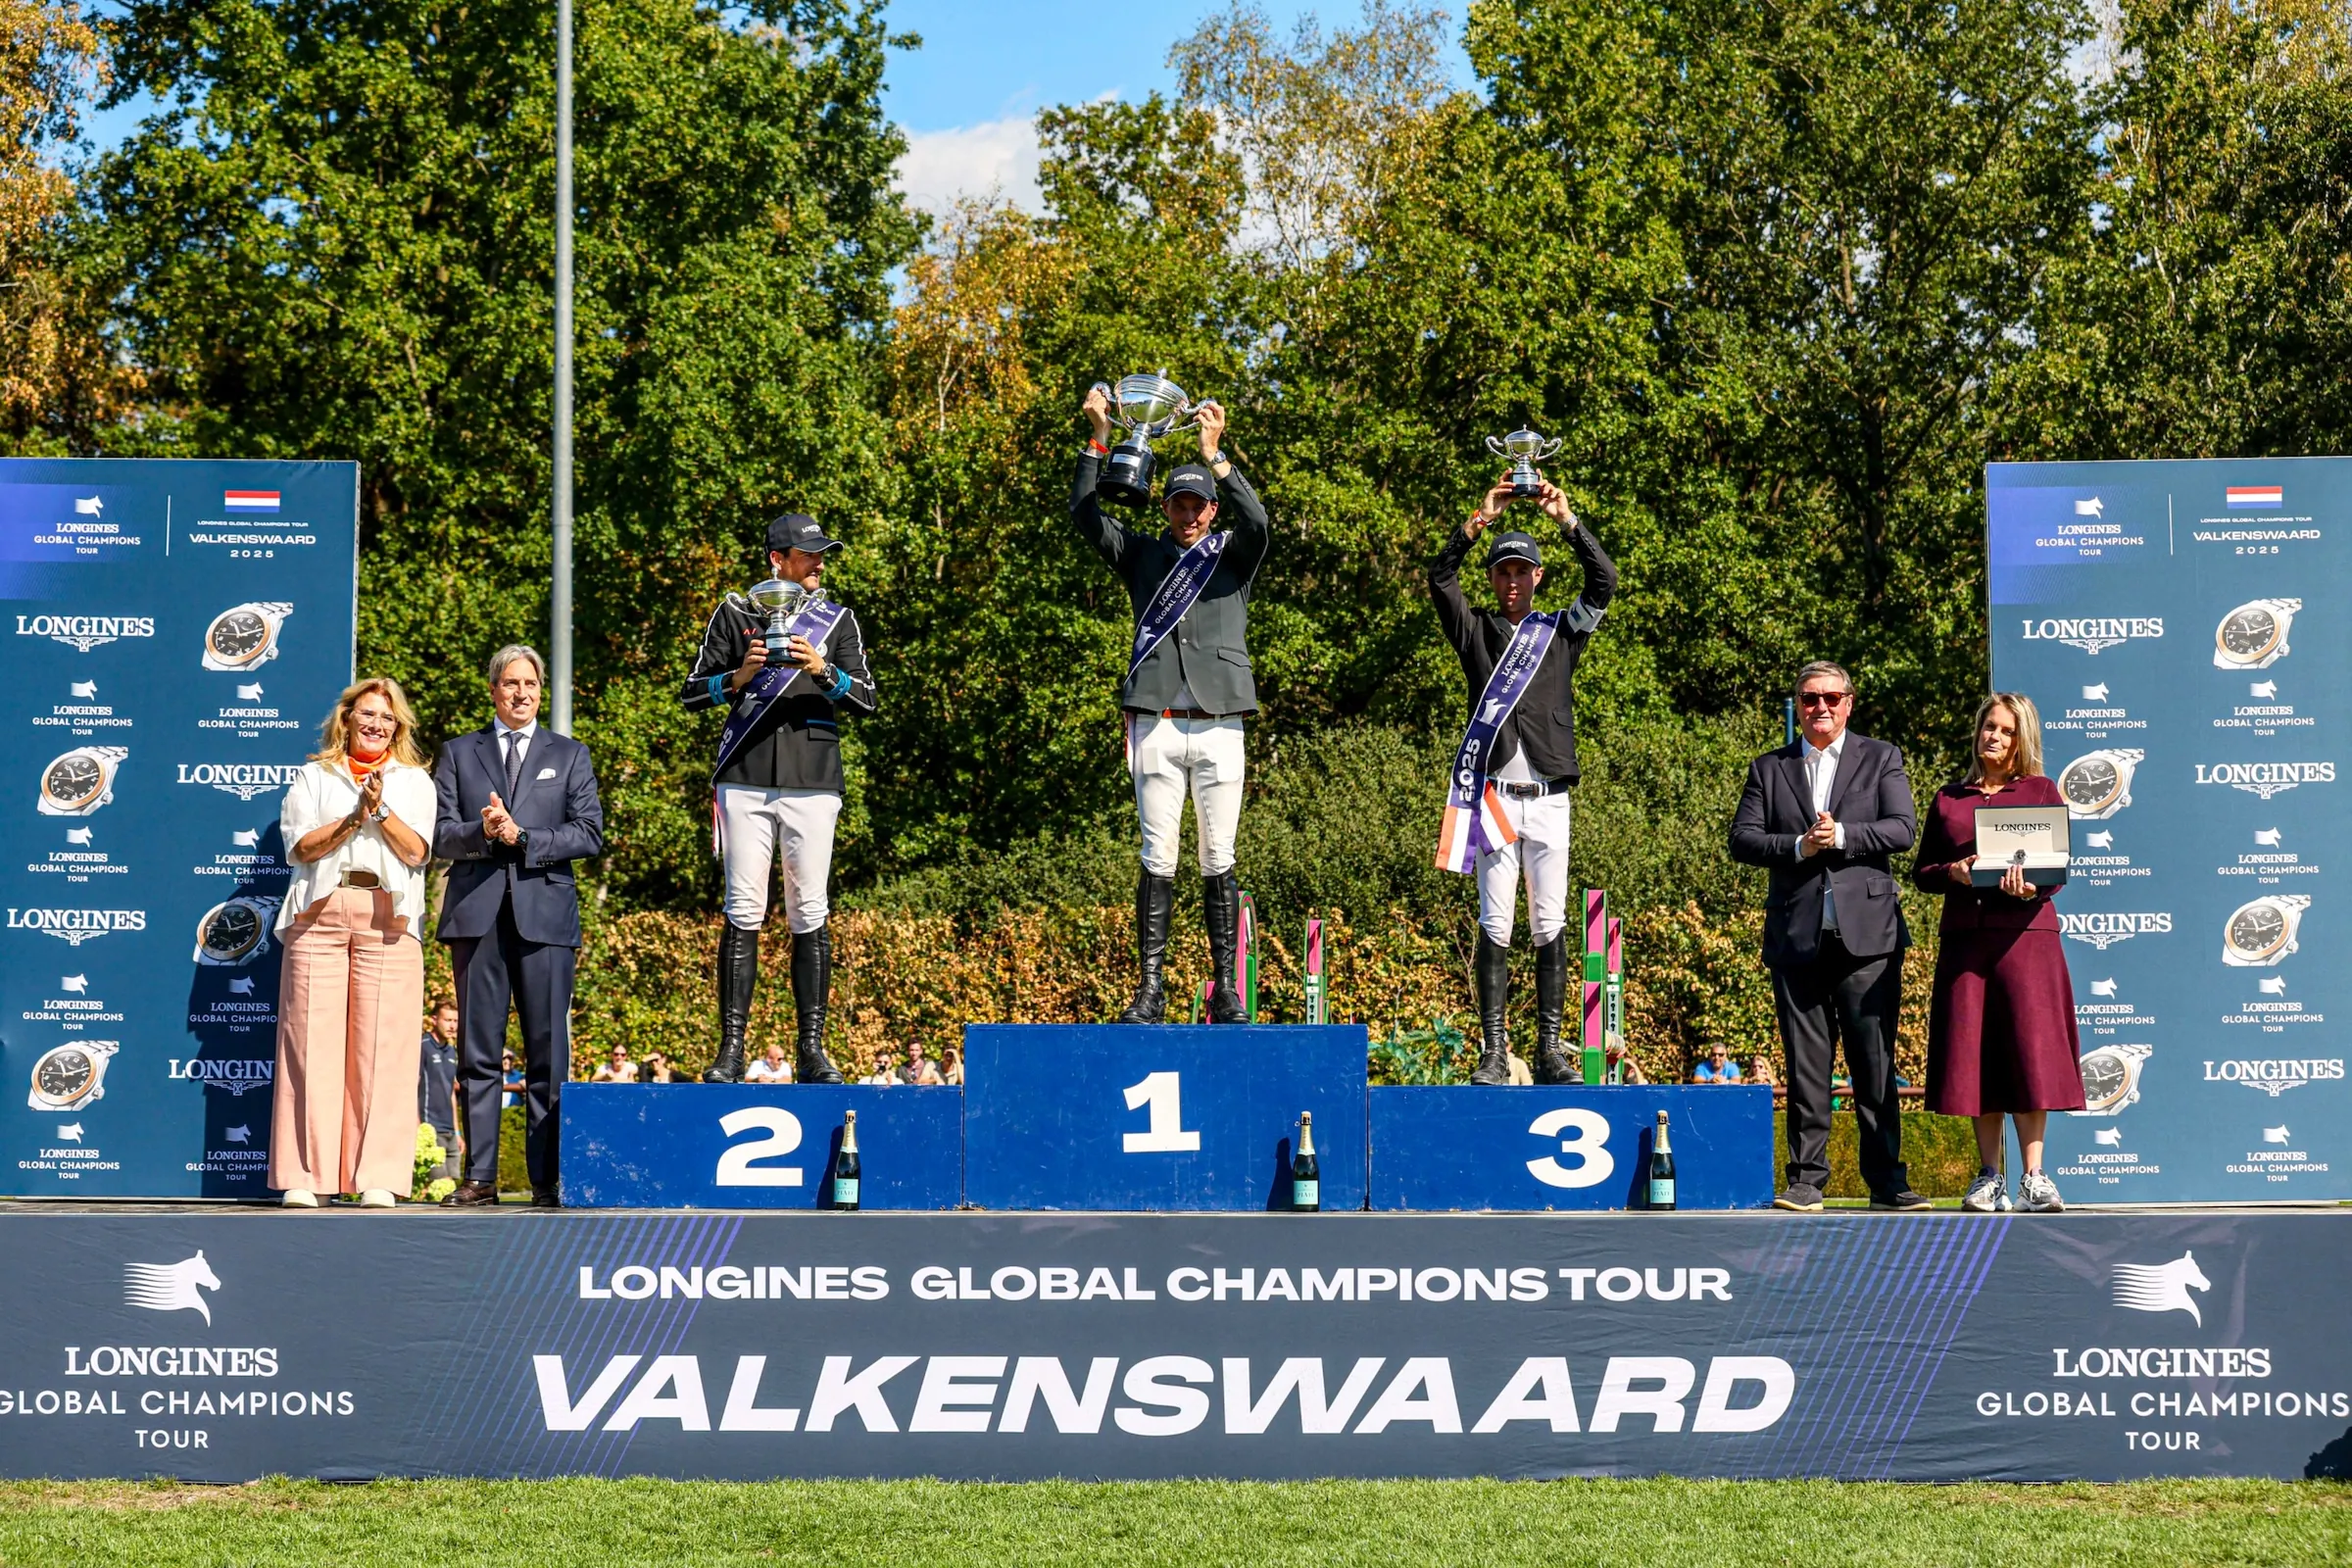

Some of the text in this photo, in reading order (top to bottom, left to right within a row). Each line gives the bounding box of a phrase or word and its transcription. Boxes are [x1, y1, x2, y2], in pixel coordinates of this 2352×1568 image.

[57, 523, 119, 533] LONGINES
[2058, 524, 2121, 534] LONGINES
[34, 535, 141, 545] GLOBAL CHAMPIONS
[190, 534, 316, 544] VALKENSWAARD
[2193, 530, 2321, 541] VALKENSWAARD
[2081, 537, 2143, 546] CHAMPIONS
[1158, 566, 1189, 607] LONGINES
[1180, 588, 1194, 604] TOUR
[1154, 600, 1176, 624] GLOBAL
[17, 615, 154, 636] LONGINES
[2023, 617, 2164, 639] LONGINES
[1501, 633, 1529, 676] LONGINES
[1501, 624, 1542, 694] GLOBAL CHAMPIONS
[1525, 655, 1536, 669] TOUR
[54, 706, 112, 715] LONGINES
[220, 709, 278, 717] LONGINES
[2066, 709, 2126, 718] LONGINES
[2234, 706, 2293, 715] LONGINES
[2255, 717, 2314, 726] CHAMPIONS
[177, 764, 301, 784] LONGINE
[1459, 739, 1481, 802] 2025
[2195, 762, 2335, 783] LONGINES
[49, 853, 108, 862] LONGINES
[216, 855, 273, 864] LONGINES
[2070, 856, 2130, 865] LONGINES
[2238, 854, 2297, 863] LONGINES
[2260, 865, 2319, 874] CHAMPIONS
[7, 908, 145, 930] LONGINES
[44, 1001, 103, 1009] LONGINES
[211, 1003, 270, 1011] LONGINES
[2074, 1004, 2133, 1014] LONGINES
[2243, 1003, 2302, 1011] LONGINES
[64, 1012, 123, 1021] CHAMPIONS
[231, 1014, 277, 1023] CHAMPIO
[169, 1059, 274, 1079] LONGIN
[2204, 1059, 2344, 1080] LONGINES
[1123, 1072, 1200, 1152] 1
[716, 1106, 803, 1186] 2
[1527, 1108, 1614, 1188] 3
[40, 1149, 99, 1158] LONGINES
[208, 1152, 266, 1160] LONGINES
[2079, 1153, 2138, 1163] LONGINES
[2247, 1152, 2307, 1161] LONGINES
[2268, 1163, 2328, 1172] CHAMPIONS
[580, 1266, 1733, 1301] LONGINES GLOBAL CHAMPIONS TOUR
[65, 1347, 278, 1377] LONGINES
[2053, 1348, 2271, 1377] LONGINES
[533, 1355, 1794, 1436] VALKENSWAARD
[141, 1391, 354, 1415] CHAMPIONS
[1977, 1392, 2349, 1416] GLOBAL CHAMPIONS
[135, 1430, 208, 1447] TOUR
[2126, 1432, 2199, 1449] TOUR
